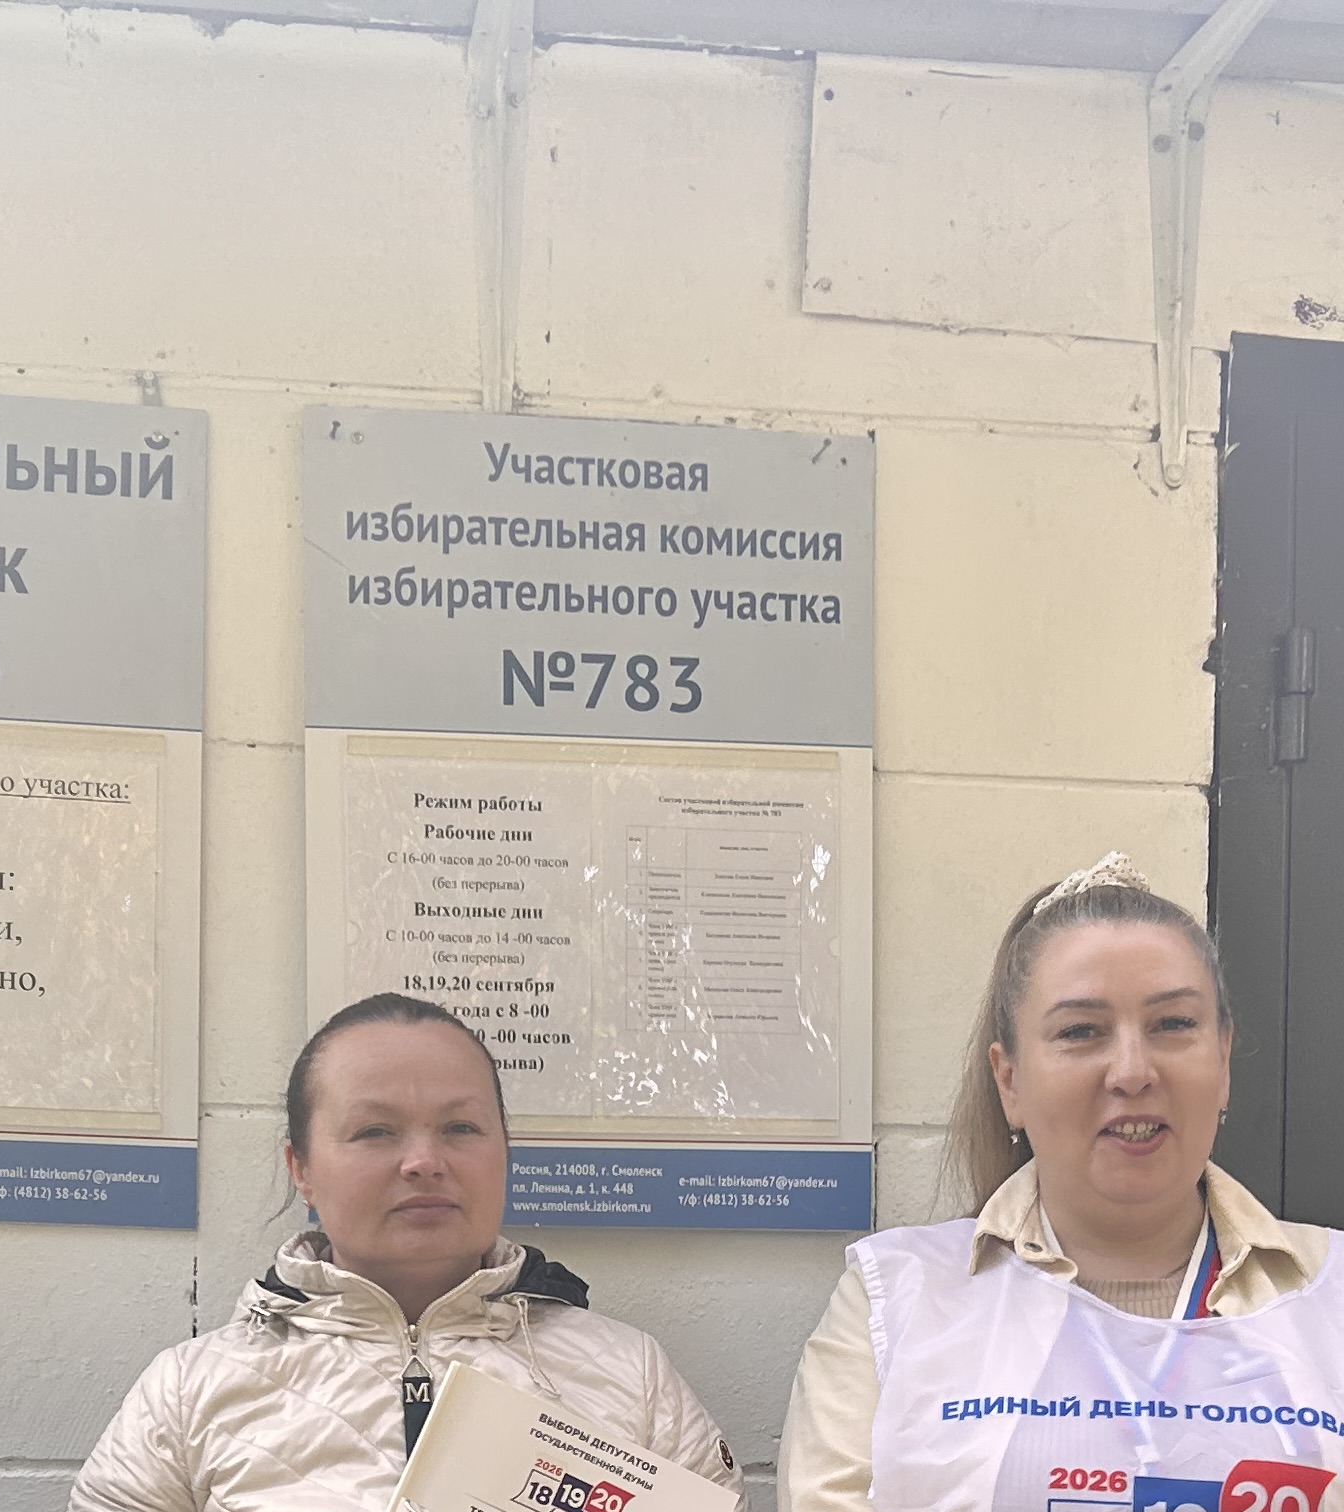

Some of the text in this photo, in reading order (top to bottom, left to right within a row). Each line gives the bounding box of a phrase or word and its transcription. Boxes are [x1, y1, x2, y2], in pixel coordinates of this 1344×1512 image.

[484, 441, 709, 492] Участковая
[346, 501, 843, 561] избирательная комиссия
[348, 565, 841, 629] избирательного участка
[503, 649, 703, 713] №783
[22, 776, 131, 800] участка:
[414, 793, 543, 813] Режим работы
[424, 824, 533, 843] Рабочие дни
[402, 852, 436, 865] 16-00
[439, 856, 474, 866] часов
[477, 856, 493, 868] до
[496, 854, 531, 868] 20-00
[534, 857, 569, 868] часов
[432, 877, 525, 892] (без перерыва)
[414, 902, 544, 921] Выходные дни
[401, 930, 435, 943] 10-00
[438, 933, 473, 944] часов
[476, 934, 492, 945] до
[536, 935, 571, 946] часов
[432, 951, 525, 967] (без перерыва)
[475, 978, 555, 996] сентября
[454, 1005, 490, 1019] года
[509, 1003, 518, 1018] 8
[522, 1032, 571, 1044] часов
[492, 1056, 544, 1072] рыва)
[512, 1163, 552, 1177] Россия,
[555, 1163, 599, 1178] 214008,
[612, 1165, 663, 1177] Смоленск
[13, 1186, 52, 1201] (4812)
[54, 1187, 108, 1202] 38-62-56
[530, 1182, 574, 1196] Ленина,
[613, 1183, 634, 1195] 448
[703, 1193, 738, 1208] (4812)
[740, 1194, 790, 1207] 38-62-56
[942, 1396, 1080, 1421] ЕДИНЫЙ
[1090, 1400, 1177, 1419] ДЕНЬ
[538, 1412, 658, 1476] ВЫБОРЫ ДЕПУТАТОВ
[529, 1427, 654, 1492] ГОСУДАРСТВЕННОЙ ДУМЫ
[534, 1458, 563, 1477] 2026
[1048, 1467, 1127, 1492] 2026
[528, 1482, 553, 1506] 18
[559, 1483, 586, 1510] 19
